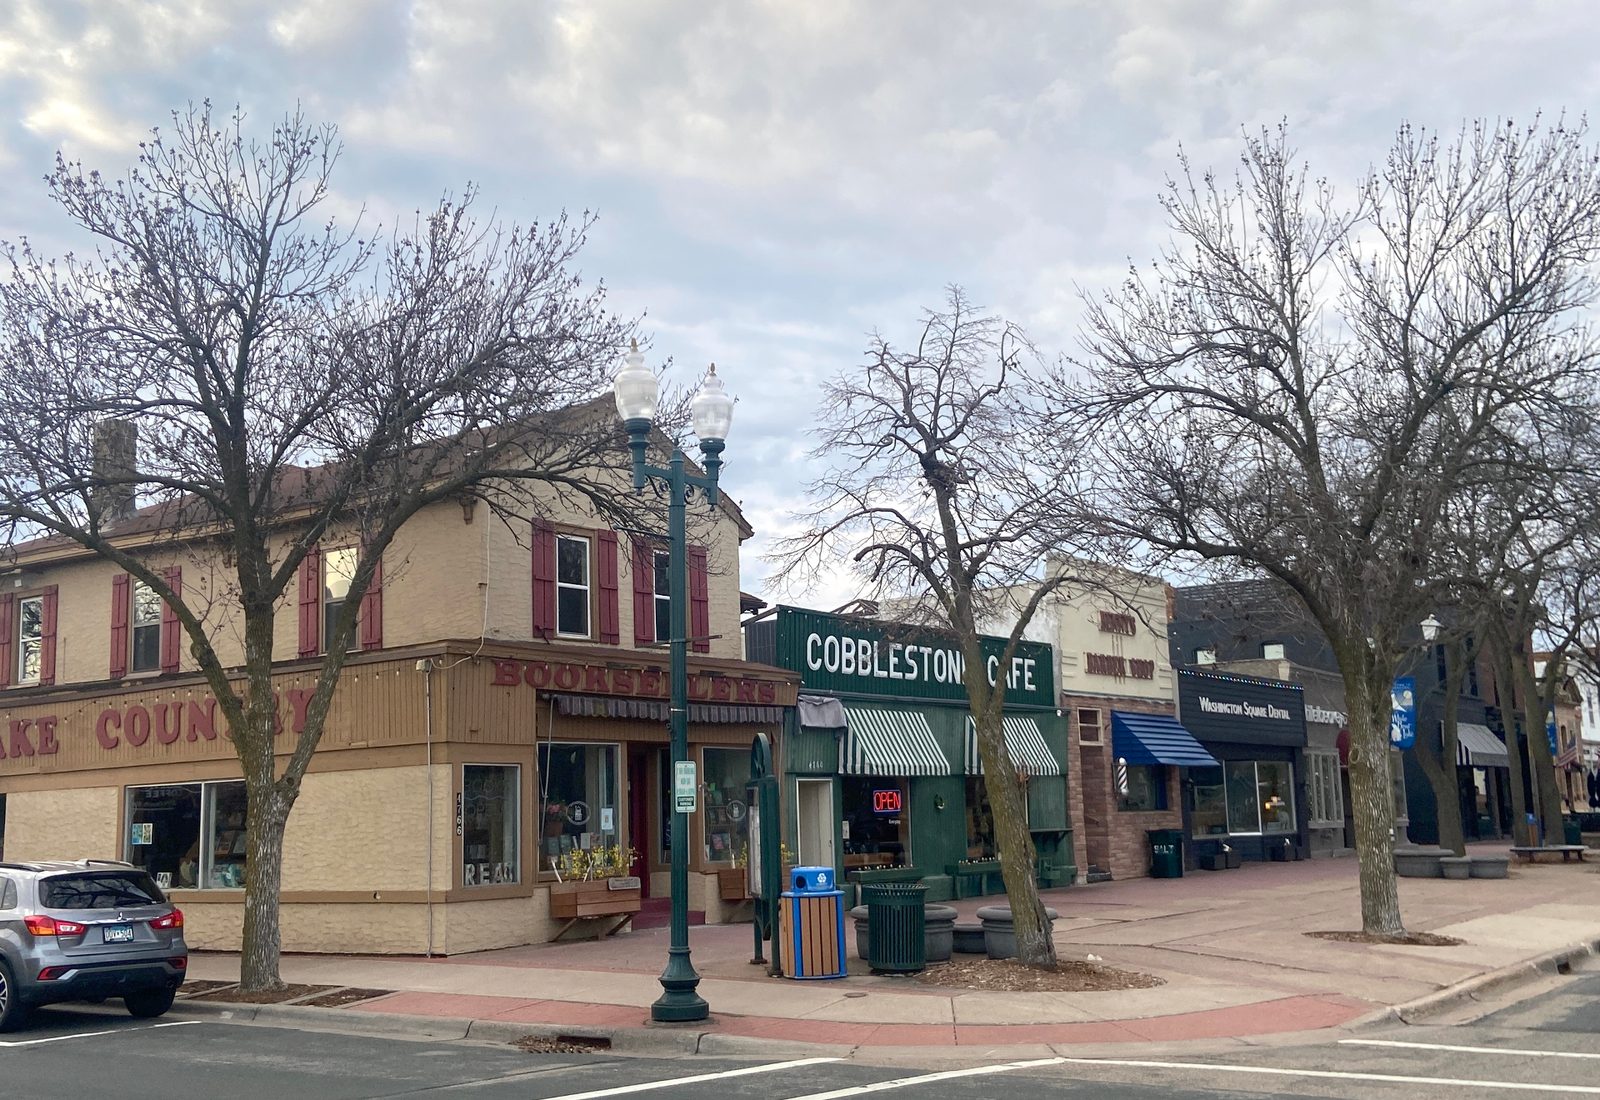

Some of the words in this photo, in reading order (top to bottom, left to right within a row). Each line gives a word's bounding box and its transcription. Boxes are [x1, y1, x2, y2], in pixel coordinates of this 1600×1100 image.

[96, 686, 319, 750] COUNY
[874, 791, 901, 810] OPEN
[1153, 844, 1174, 854] SALT
[464, 862, 513, 886] READ
